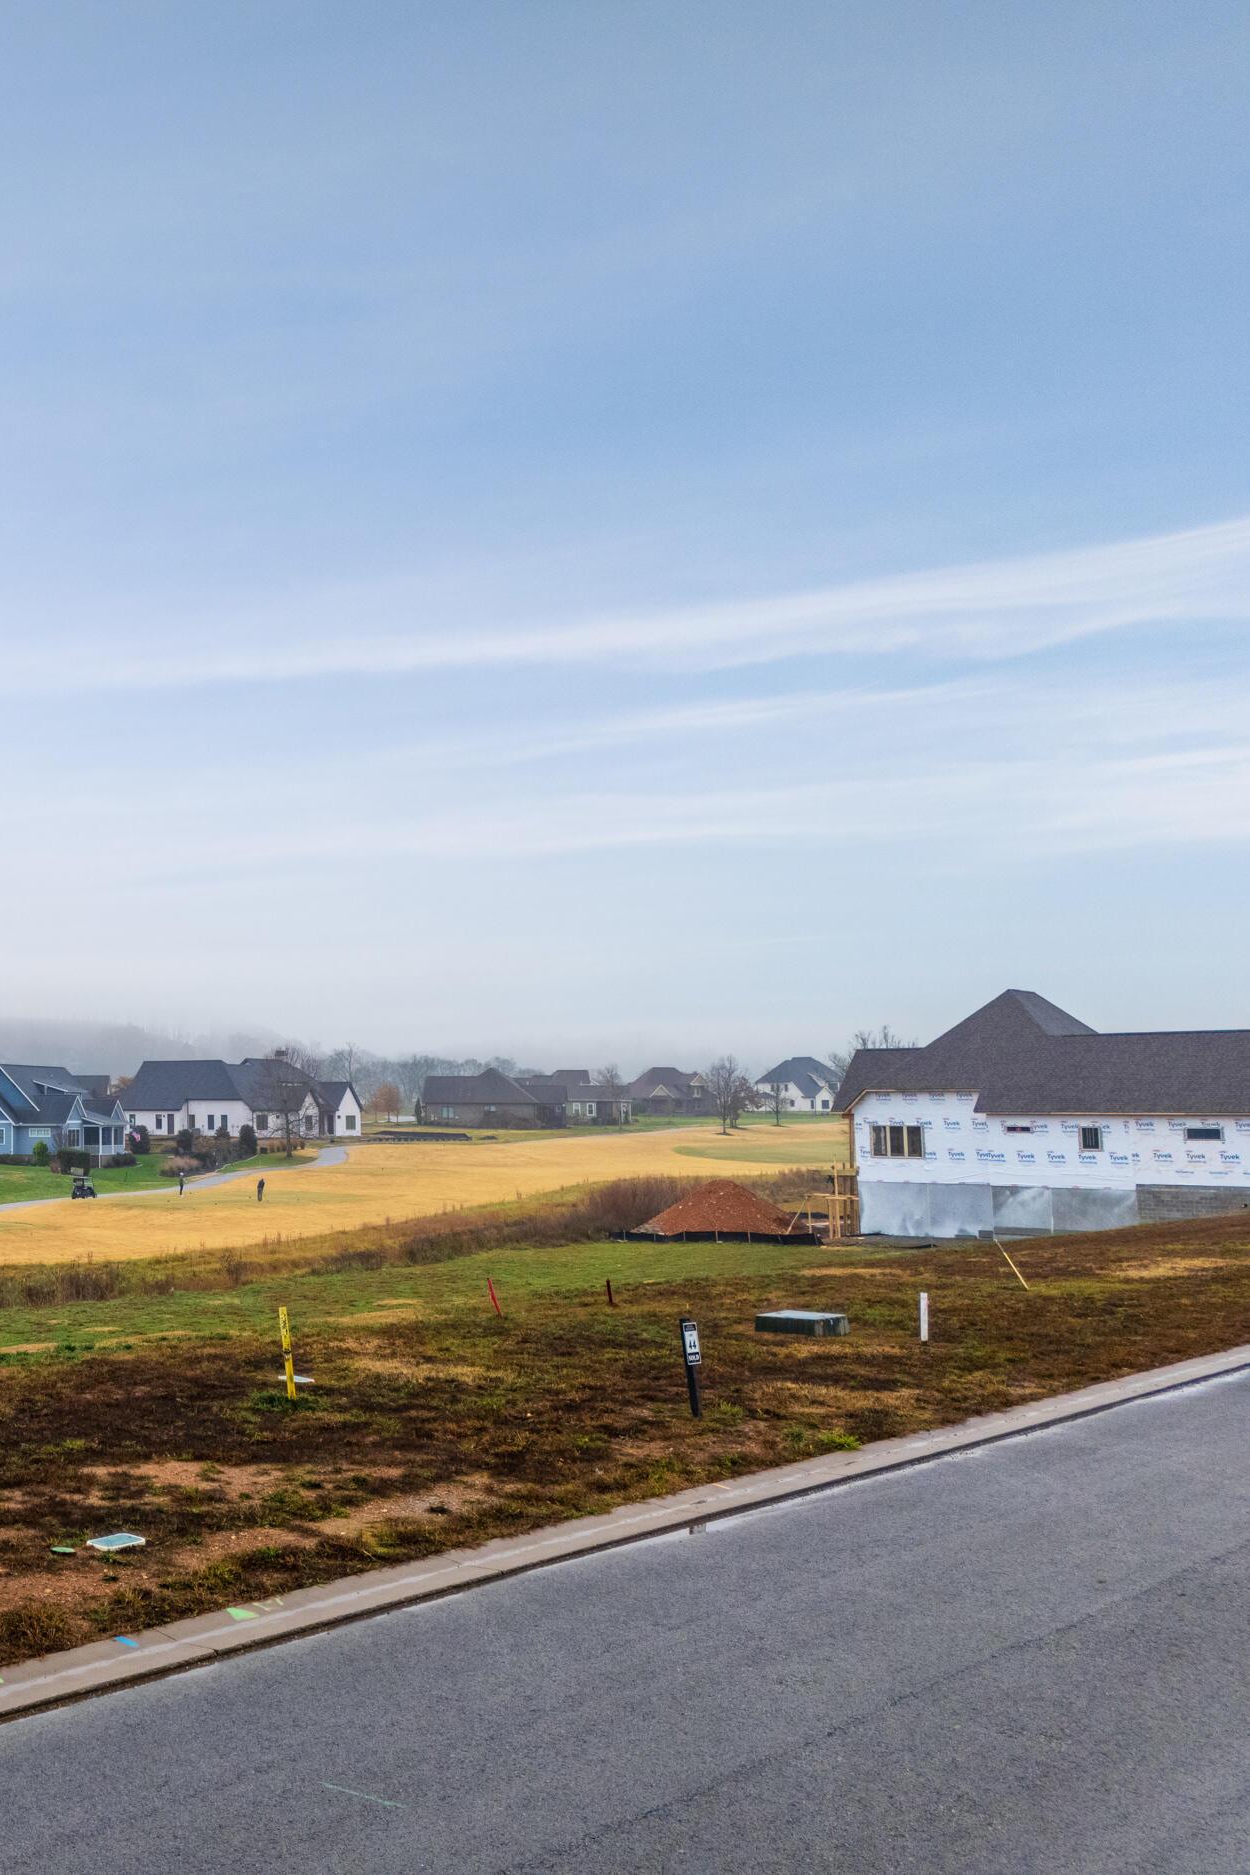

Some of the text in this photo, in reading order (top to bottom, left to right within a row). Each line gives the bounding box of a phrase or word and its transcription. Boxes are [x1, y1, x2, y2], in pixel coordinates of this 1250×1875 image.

[1135, 1120, 1154, 1128] Tyvek
[1017, 1152, 1035, 1160] Tyvek
[1153, 1152, 1172, 1160] Tyvek
[688, 1339, 697, 1350] 44
